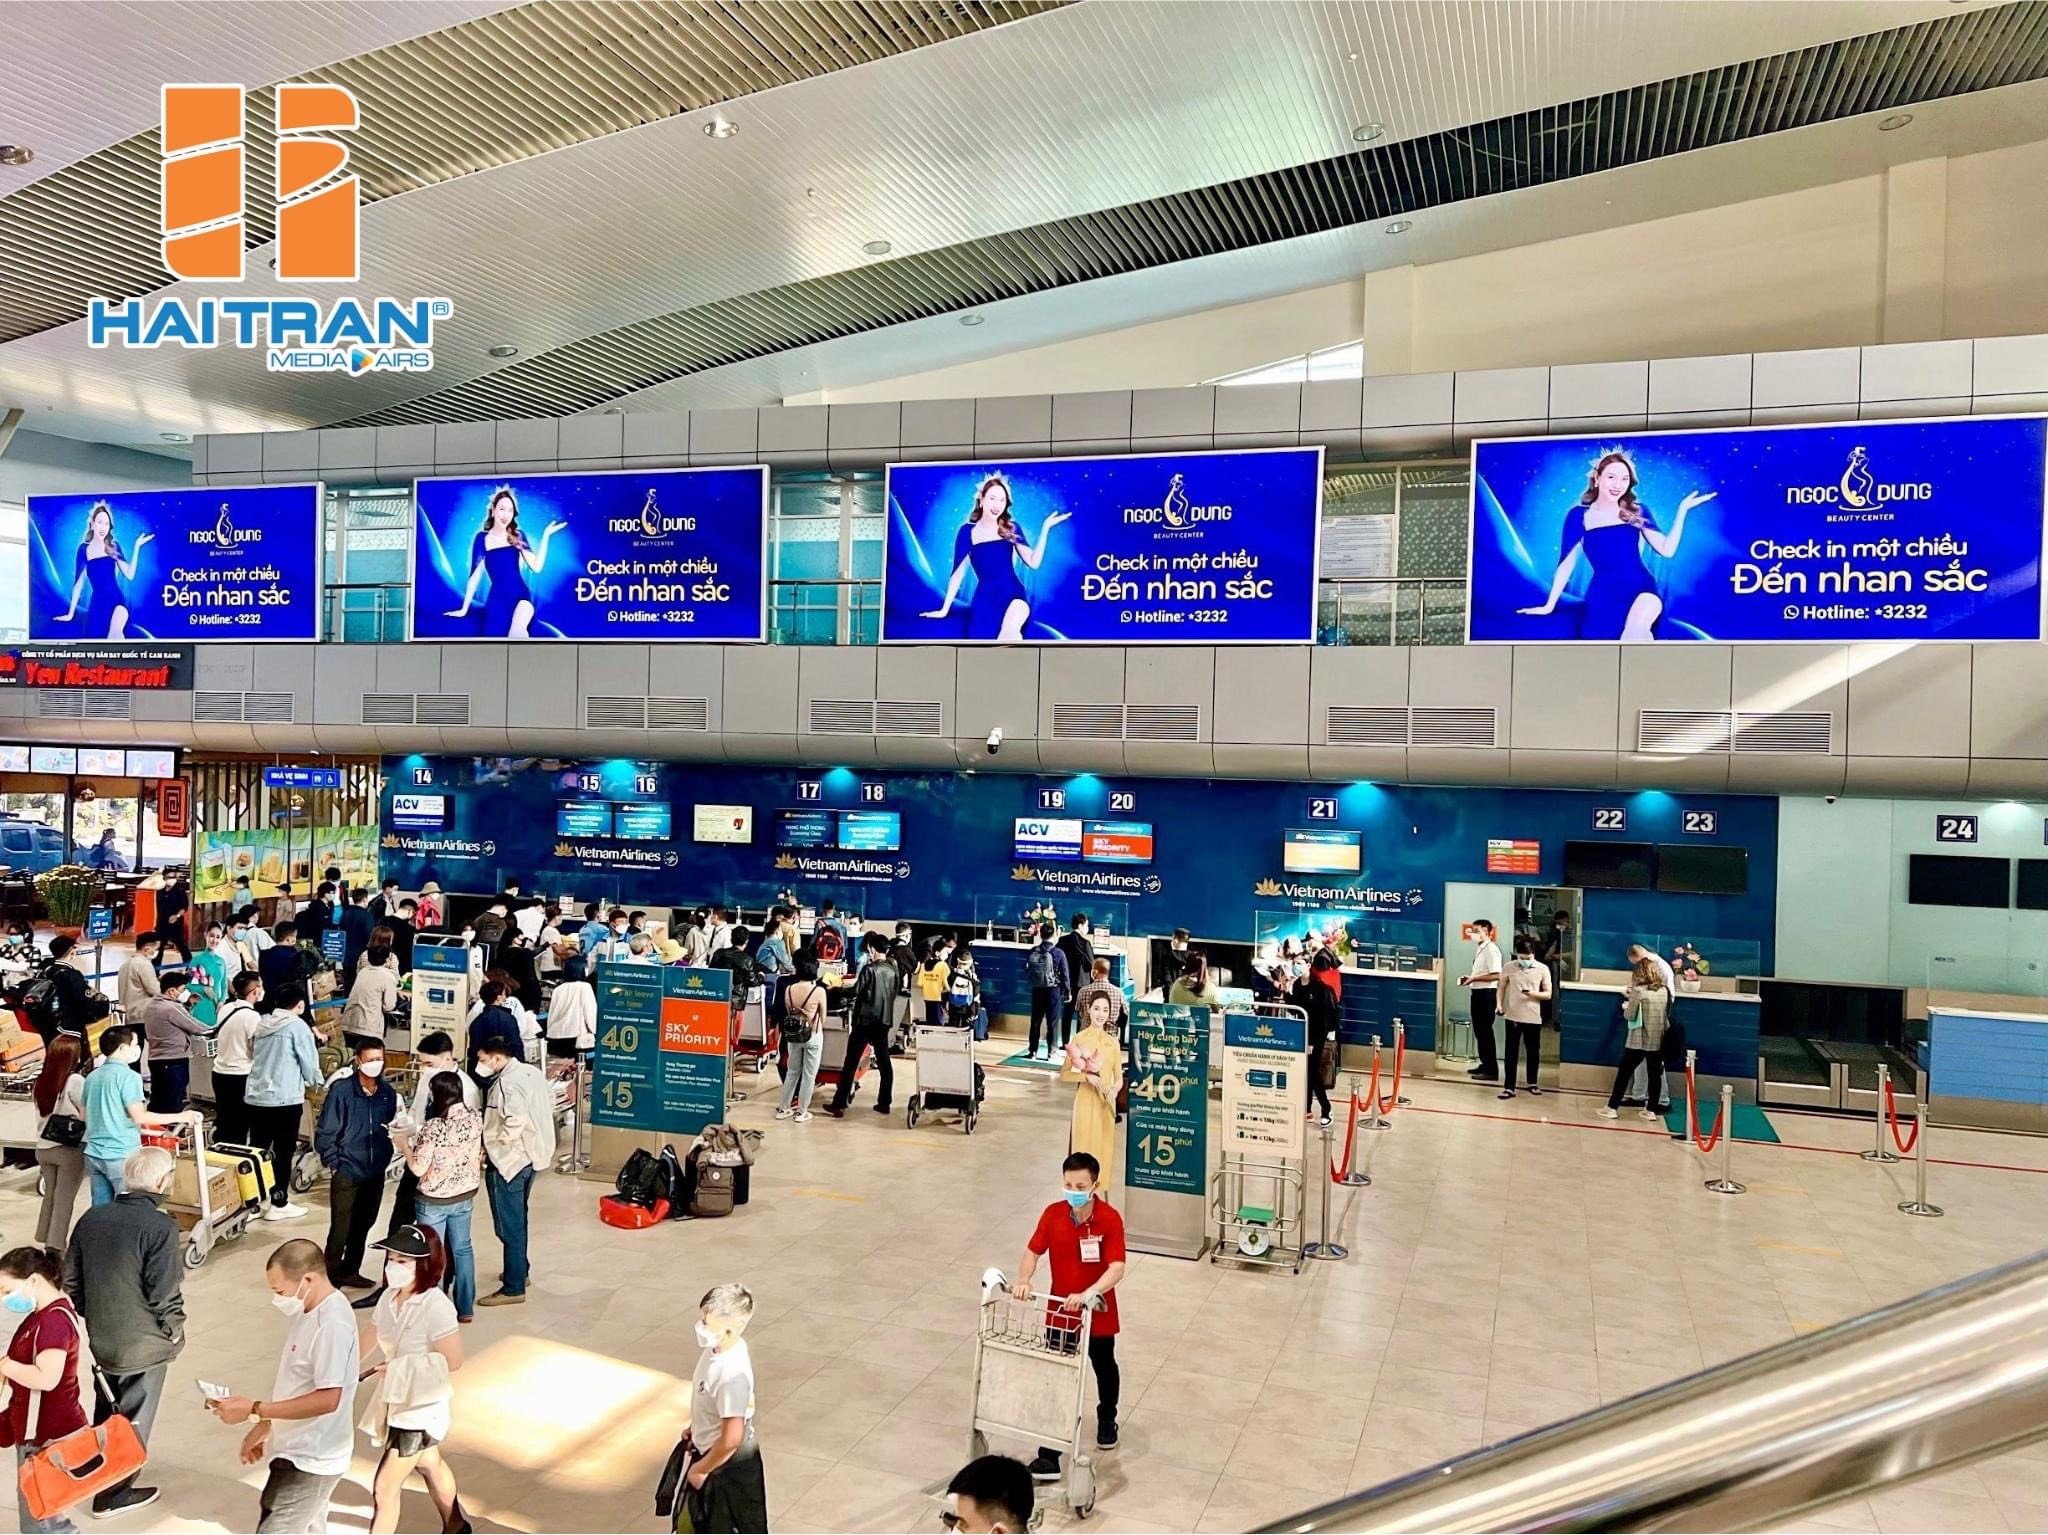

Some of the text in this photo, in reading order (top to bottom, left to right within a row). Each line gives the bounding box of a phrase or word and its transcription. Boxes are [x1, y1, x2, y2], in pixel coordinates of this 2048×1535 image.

[1877, 483, 1932, 501] DUNG
[1191, 506, 1232, 521] DUNG
[1827, 514, 1860, 522] BEAUTY
[663, 518, 696, 531] DUNG
[234, 529, 261, 541] DUNG
[1750, 533, 1968, 561] Check in một chiều
[587, 557, 717, 577] Check in một chiều
[1096, 549, 1258, 573] Check in một chiều
[172, 564, 280, 583] Check in một chiều
[1729, 559, 1988, 594] Đến nhan sắc
[575, 576, 730, 602] Đến nhan sắc
[1081, 571, 1273, 600] Đến nhan sắc
[162, 582, 290, 606] Đến nhan sắc
[199, 614, 232, 624] Hotline:
[620, 611, 659, 622] Hotline:
[1135, 610, 1185, 623] Hotline:
[1803, 605, 1870, 619] Hotline:
[64, 662, 169, 686] Restaurant
[416, 770, 432, 784] 14
[581, 775, 599, 791] 15
[637, 777, 656, 792] 16
[800, 783, 820, 798] 17
[864, 785, 883, 801] 18
[395, 799, 419, 809] ACV
[1042, 791, 1063, 807] 19
[1111, 794, 1133, 810] 20
[1312, 800, 1334, 817] 21
[1595, 810, 1623, 829] 22
[1686, 813, 1714, 831] 23
[1018, 824, 1049, 835] ACV
[1942, 820, 1973, 838] 24
[666, 1023, 689, 1033] SKY
[601, 1025, 638, 1052] 40
[665, 1033, 720, 1045] PRIORITY
[1182, 1035, 1198, 1046] bay
[602, 1080, 632, 1108] 15
[1135, 1072, 1180, 1104] 40
[1137, 1134, 1175, 1166] 15
